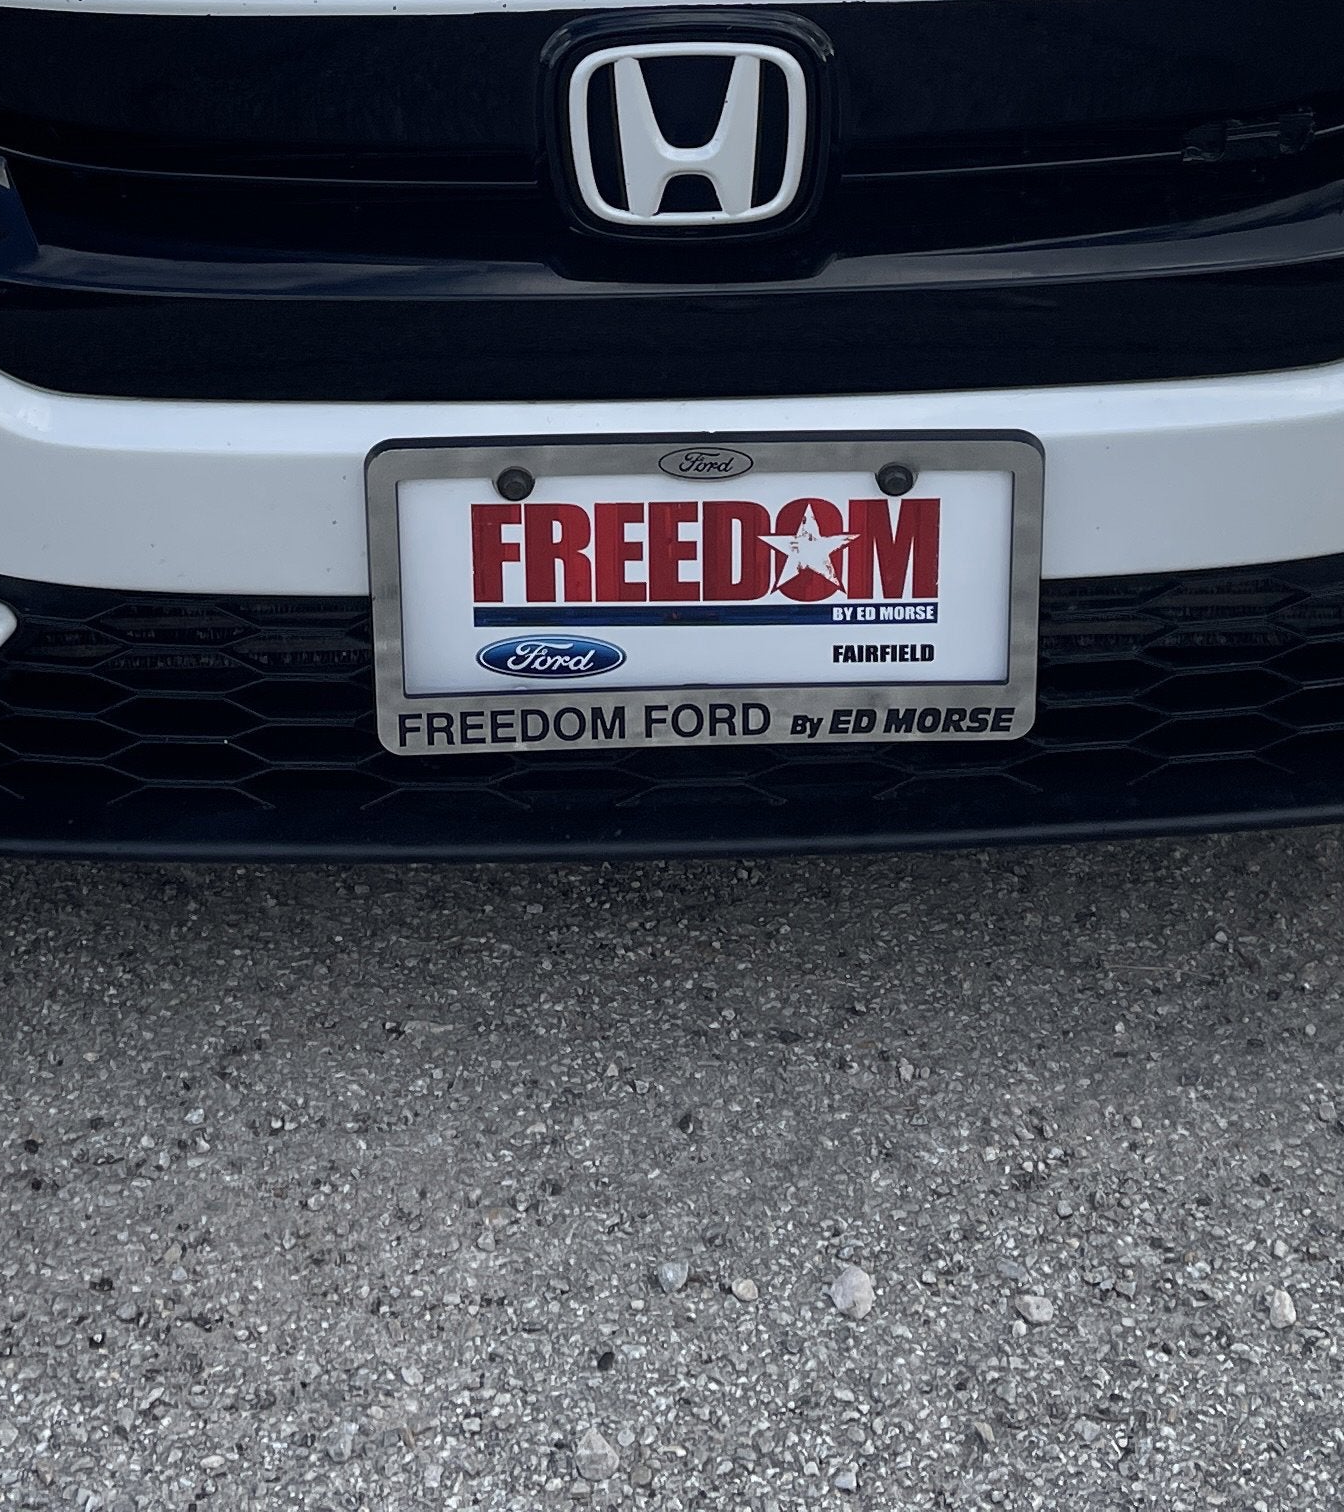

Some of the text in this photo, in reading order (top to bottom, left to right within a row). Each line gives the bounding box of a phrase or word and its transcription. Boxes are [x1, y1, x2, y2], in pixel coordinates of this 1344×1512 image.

[679, 451, 735, 473] Ford
[470, 497, 941, 603] FREEDOM
[832, 605, 935, 622] BY ED MORSE
[506, 640, 596, 671] Ford
[832, 643, 936, 663] FAIRFIELD
[397, 702, 1016, 748] FREEDOM FORD By ED MORSE
